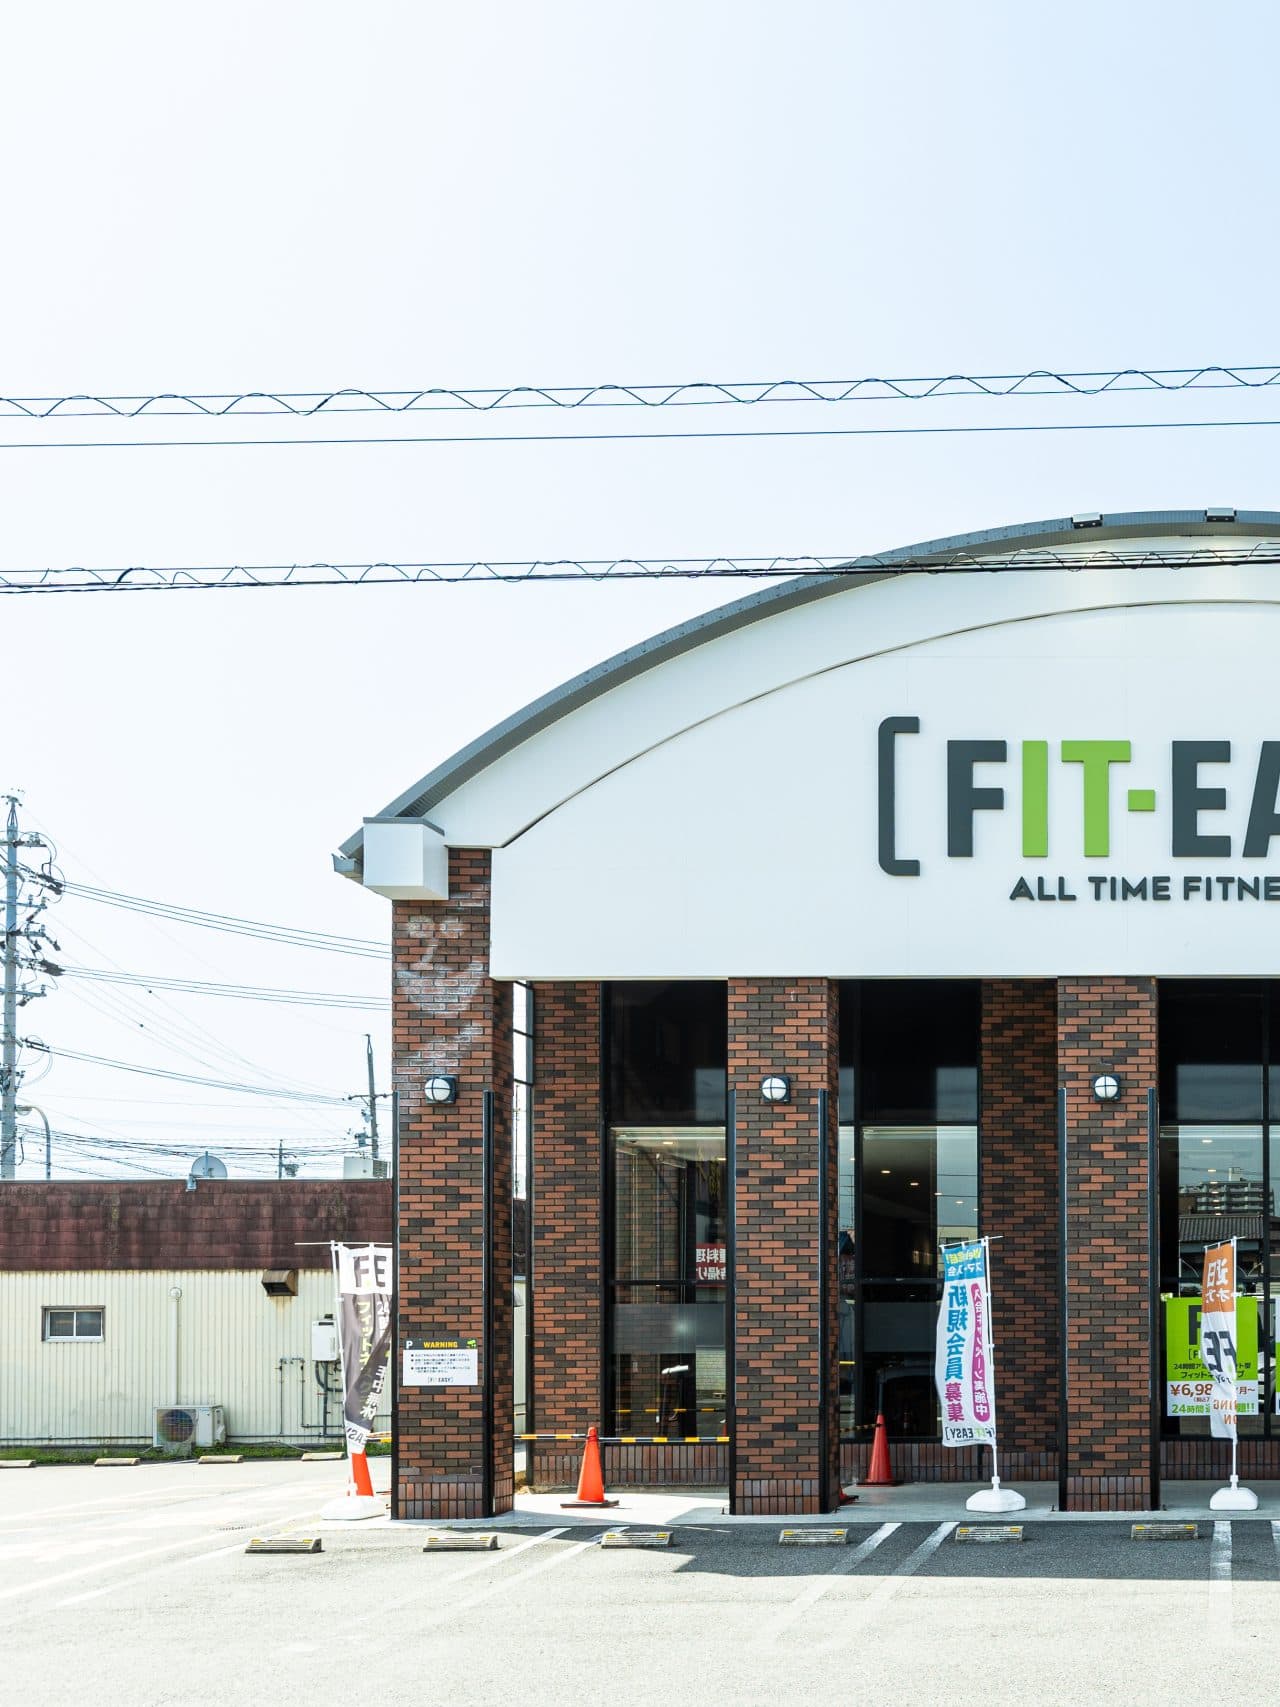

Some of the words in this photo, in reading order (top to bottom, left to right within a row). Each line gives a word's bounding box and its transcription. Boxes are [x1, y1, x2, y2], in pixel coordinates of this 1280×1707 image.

[1009, 876, 1077, 901] ALL
[1088, 876, 1171, 901] TIME
[423, 1341, 458, 1349] WARNING
